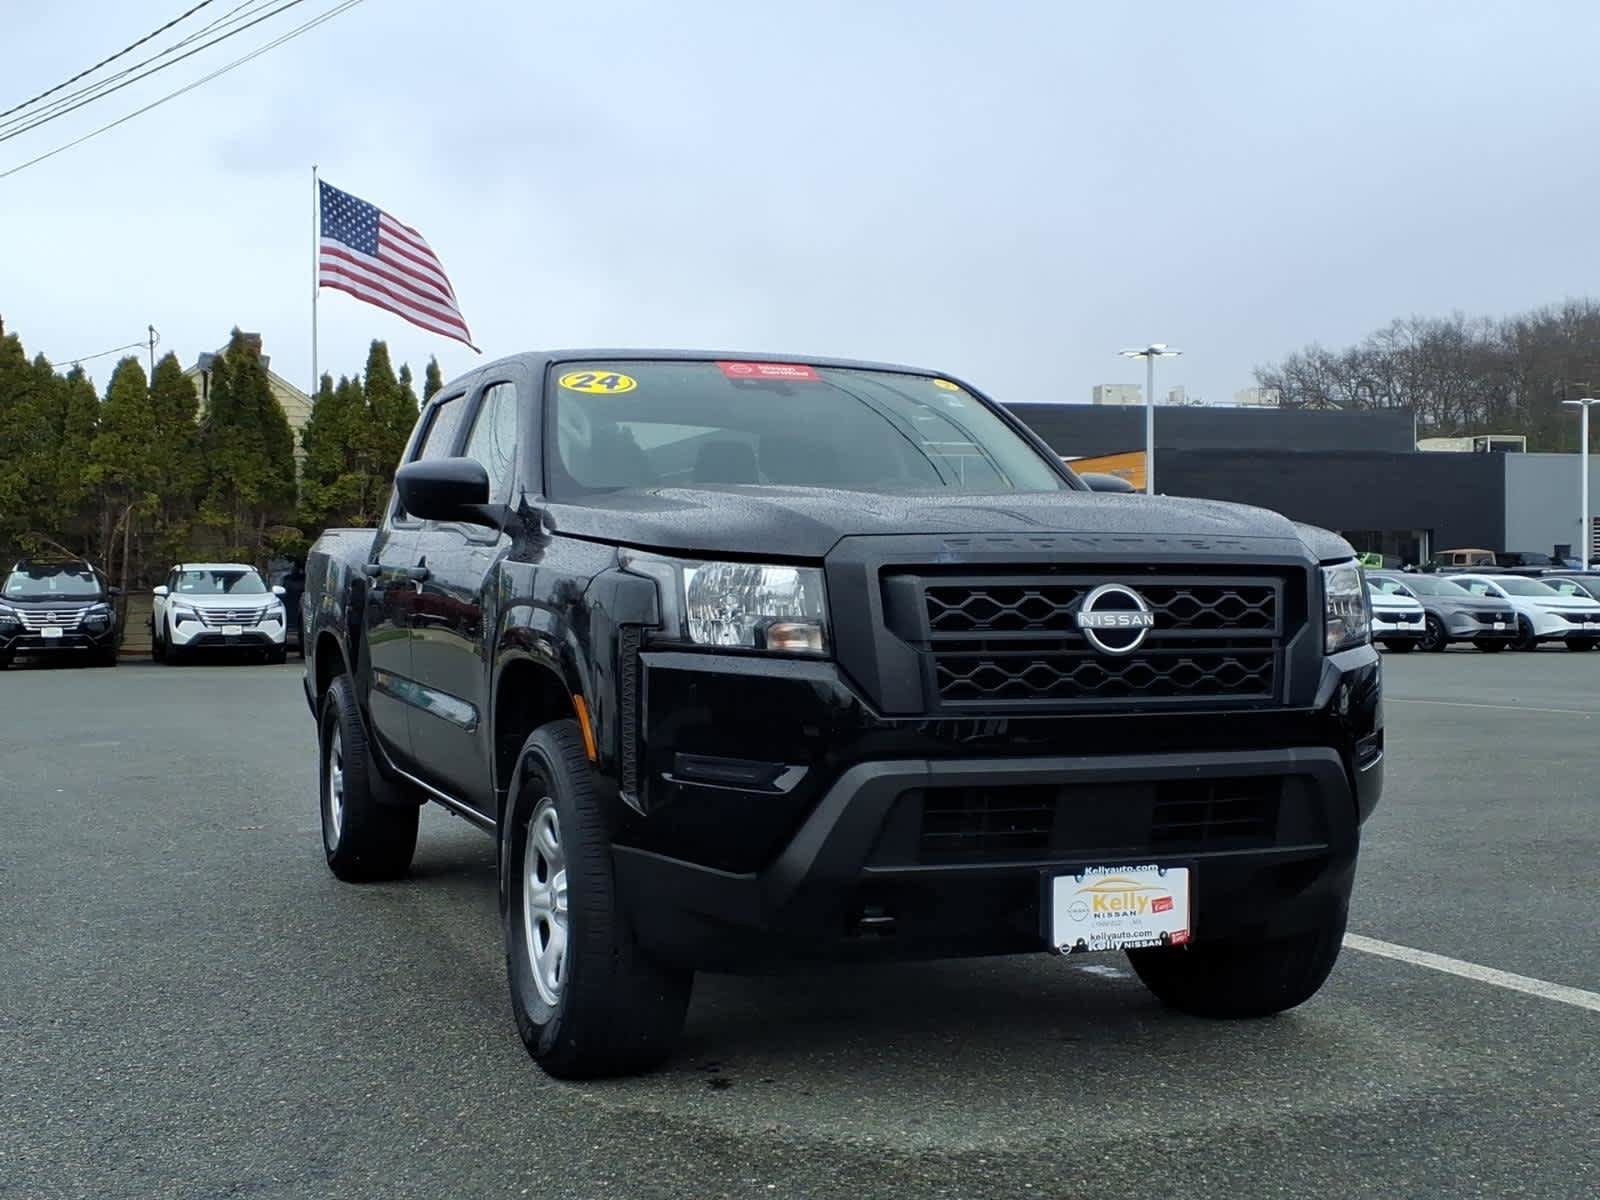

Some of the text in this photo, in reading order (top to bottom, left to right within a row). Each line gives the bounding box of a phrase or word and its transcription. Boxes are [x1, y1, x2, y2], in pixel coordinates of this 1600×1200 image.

[571, 375, 620, 389] 24
[1080, 615, 1154, 625] NISSAN
[1085, 864, 1159, 876] Kellyauto.com
[1092, 892, 1148, 913] Kelly
[1093, 910, 1137, 919] NISSAN
[1089, 930, 1153, 941] kellyauto.com
[1123, 939, 1162, 949] NISSAN
